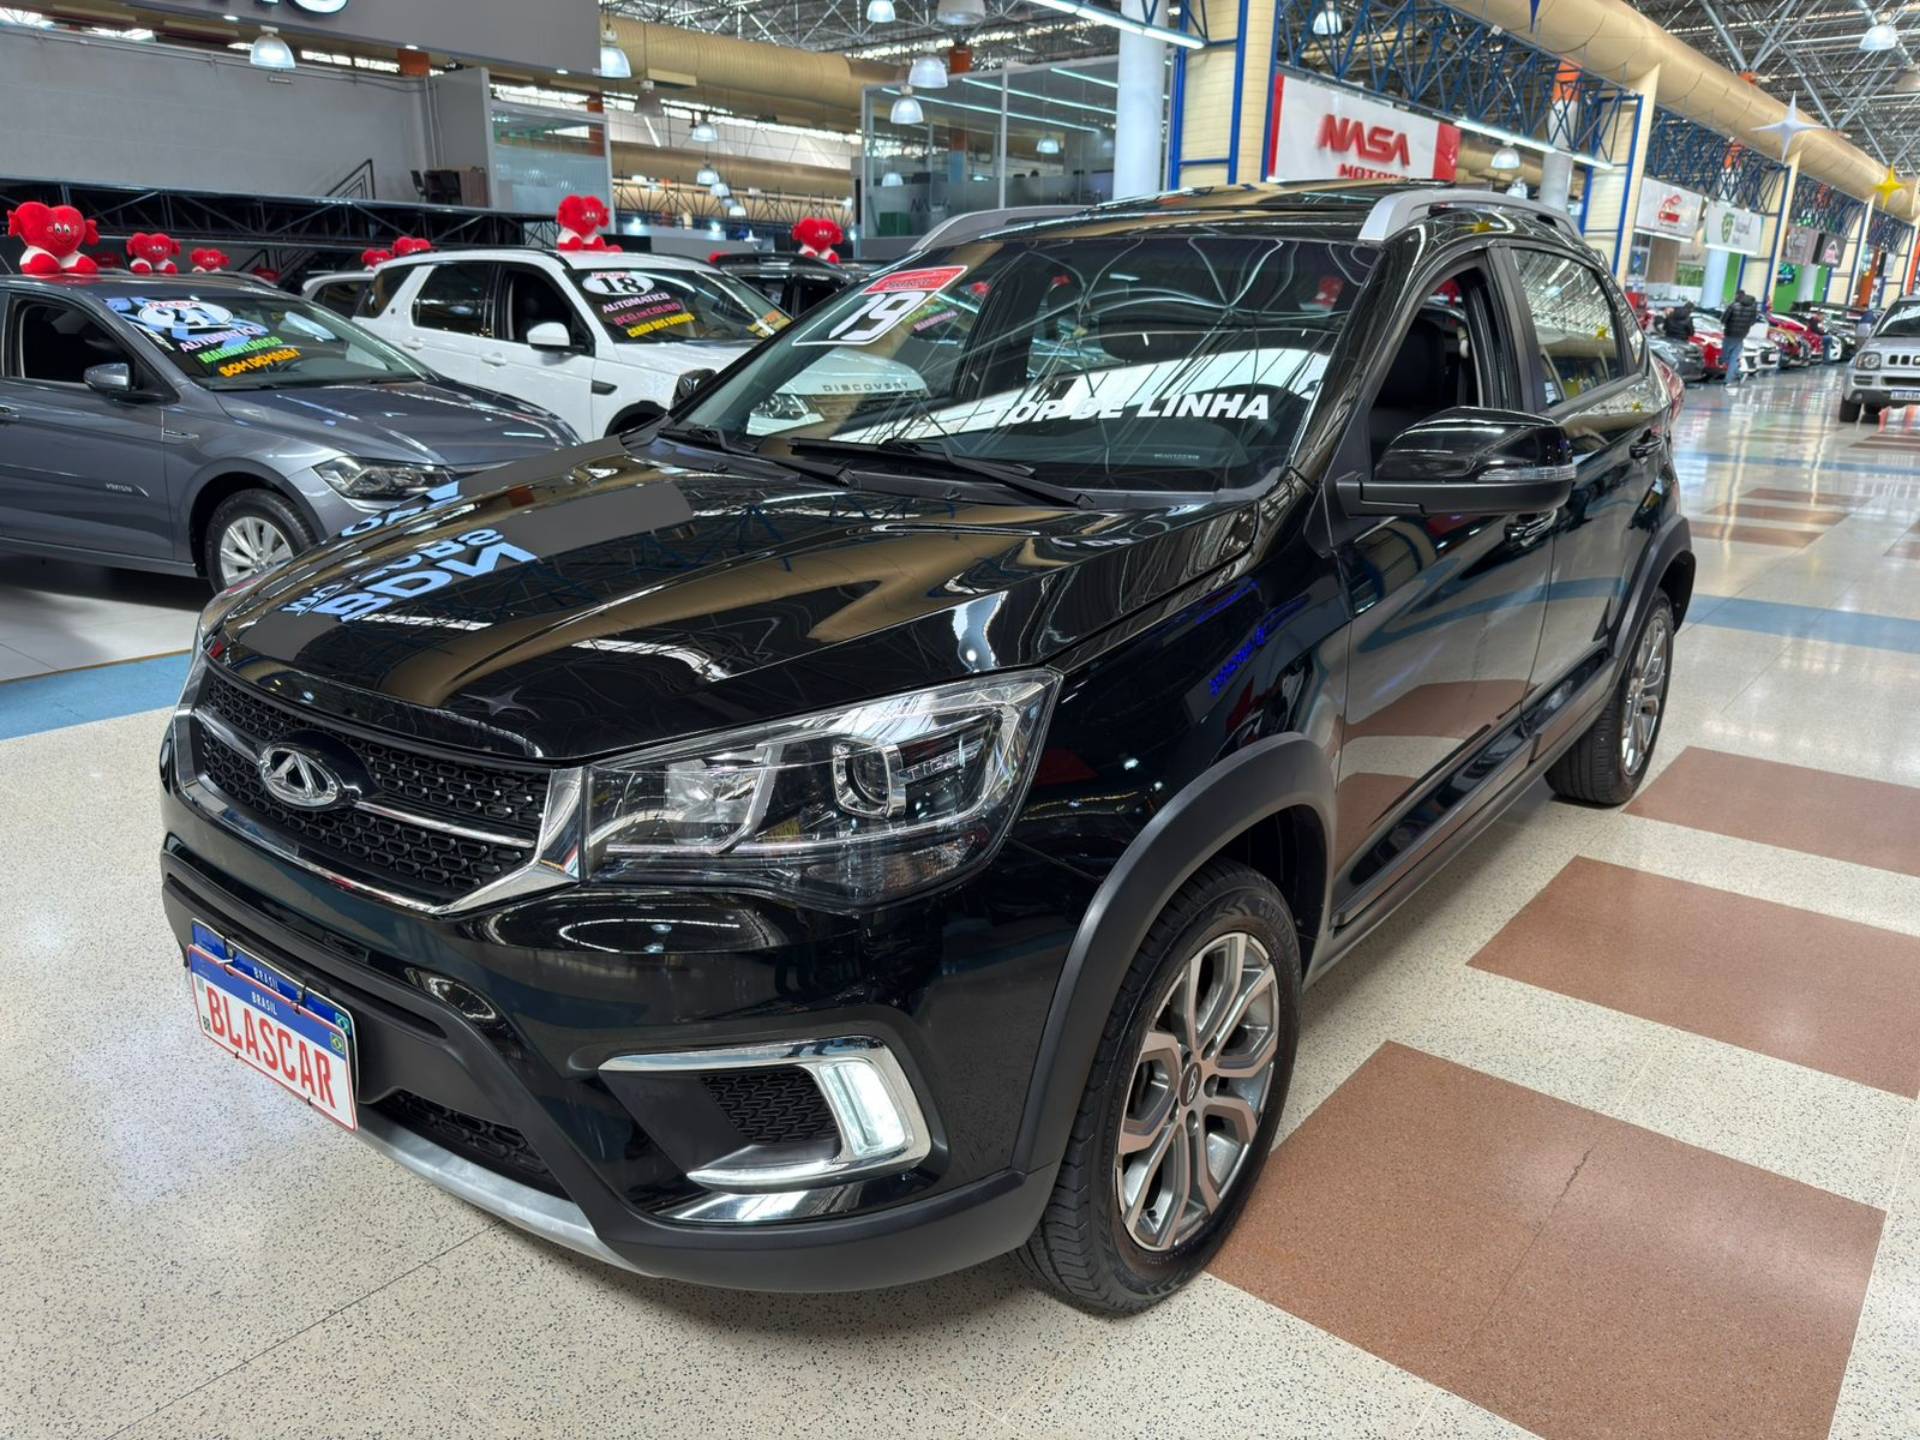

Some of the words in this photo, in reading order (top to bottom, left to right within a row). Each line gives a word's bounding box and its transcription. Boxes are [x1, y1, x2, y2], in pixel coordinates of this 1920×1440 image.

[1319, 114, 1410, 167] NASA
[1338, 163, 1409, 180] MOTO
[595, 276, 644, 294] 18
[828, 292, 926, 341] 19
[822, 381, 909, 392] DISCOVERY
[1069, 398, 1124, 421] DE
[1135, 393, 1270, 421] LINHA
[253, 967, 281, 992] BRASIL
[252, 992, 278, 1015] BRASIL
[206, 985, 336, 1109] BLASCAR
